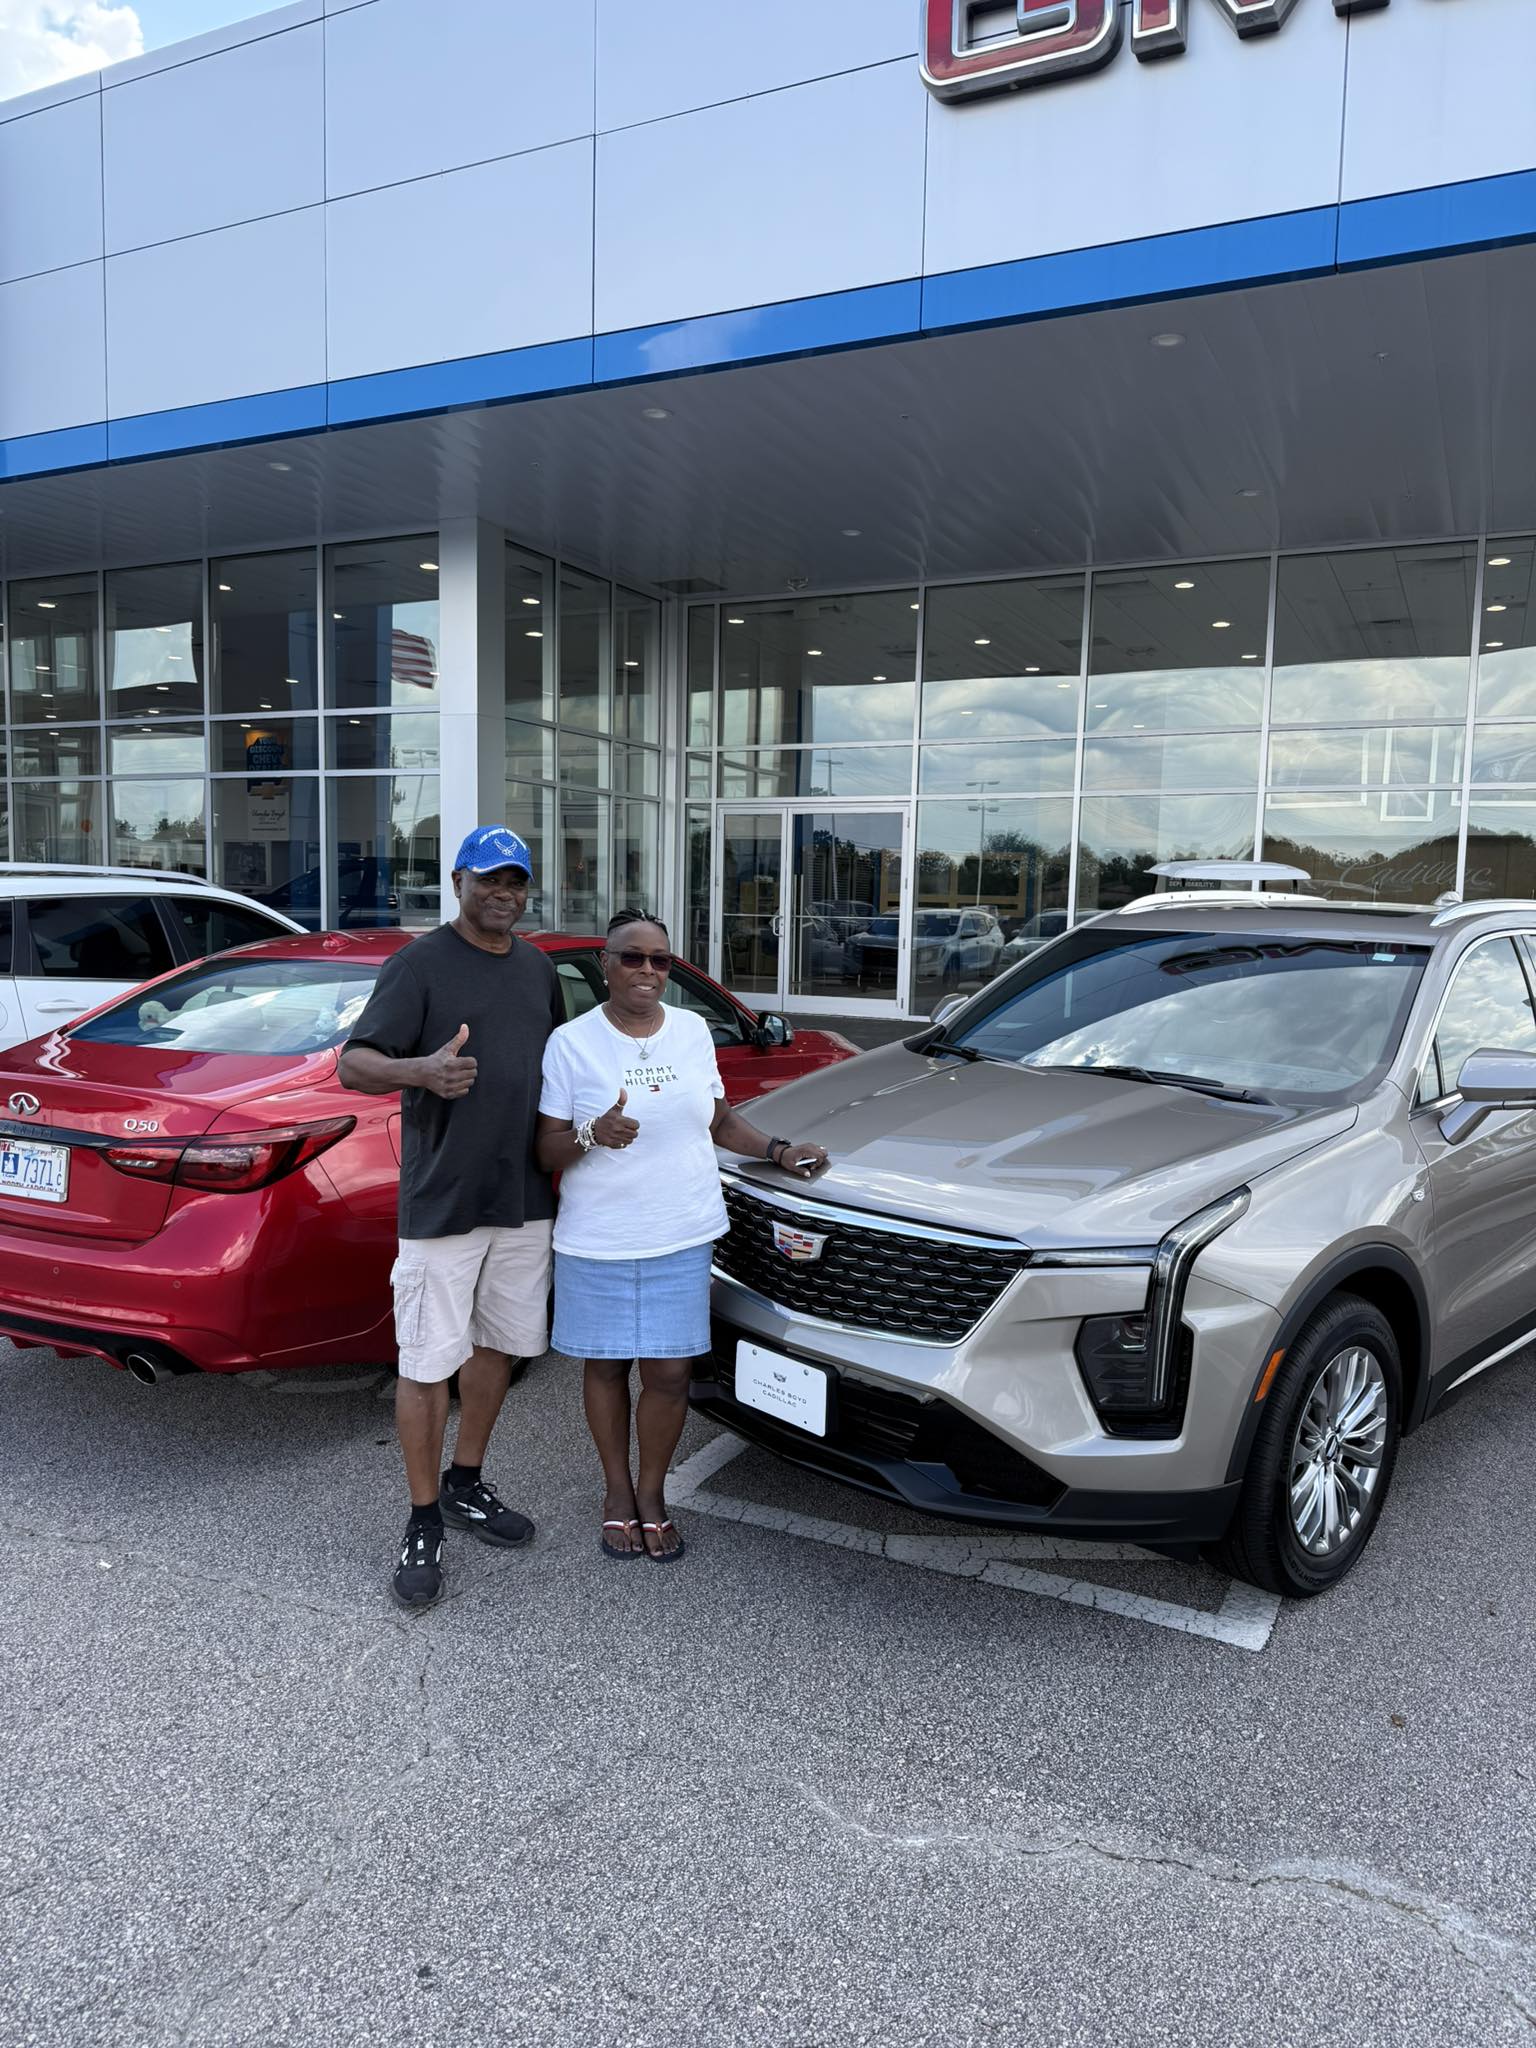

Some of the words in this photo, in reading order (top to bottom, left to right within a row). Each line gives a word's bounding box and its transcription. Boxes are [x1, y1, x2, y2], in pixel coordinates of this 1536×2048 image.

[1334, 860, 1493, 892] Cadillc
[625, 1065, 672, 1077] TOMMY
[625, 1074, 679, 1086] HILFIGER
[124, 1118, 159, 1133] Q50
[24, 1157, 53, 1186] 7371
[753, 1379, 785, 1395] CHARLES
[787, 1392, 806, 1404] BOYD
[762, 1389, 797, 1408] CADILLAC
